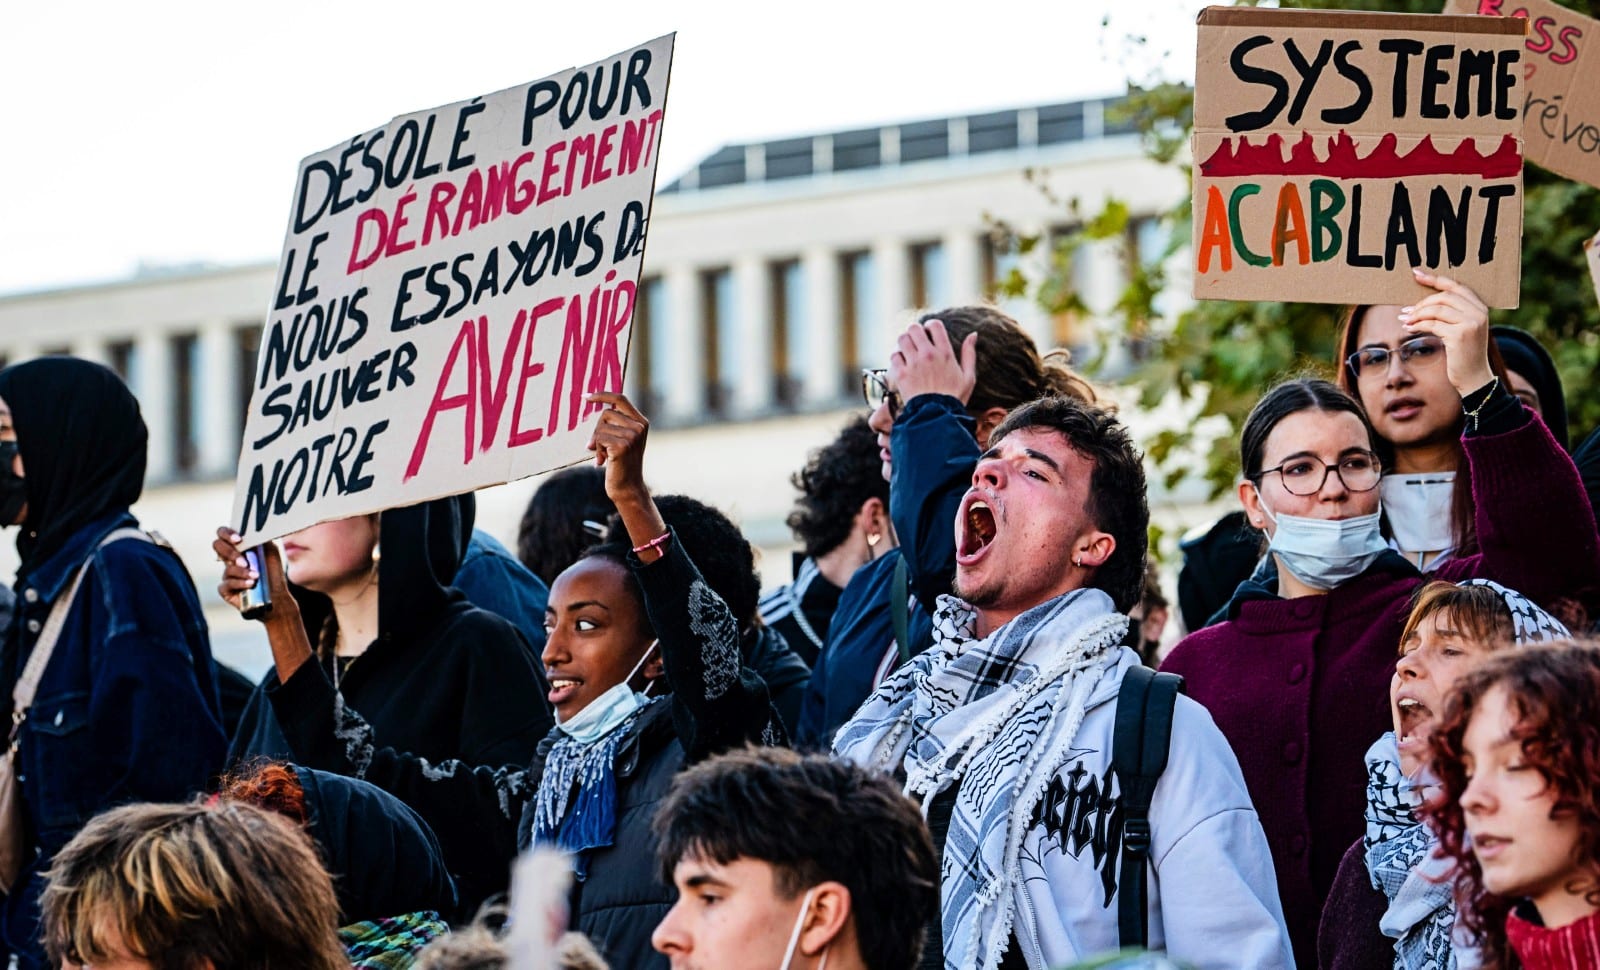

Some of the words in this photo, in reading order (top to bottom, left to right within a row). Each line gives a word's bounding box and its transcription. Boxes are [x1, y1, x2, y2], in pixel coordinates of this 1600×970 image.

[1225, 35, 1520, 133] SYSTEME
[1523, 91, 1600, 153] révo
[293, 96, 486, 234] DÉSOLÉ
[522, 48, 652, 146] POUR
[274, 232, 329, 310] LE
[346, 108, 663, 275] DÉRANGEMENT
[1198, 179, 1516, 274] ACABLANT
[259, 287, 369, 389] NOUS
[391, 210, 606, 332] ESSAYONS
[613, 200, 648, 264] DE
[253, 341, 418, 450] SAUVER
[239, 419, 389, 536] NOTRE
